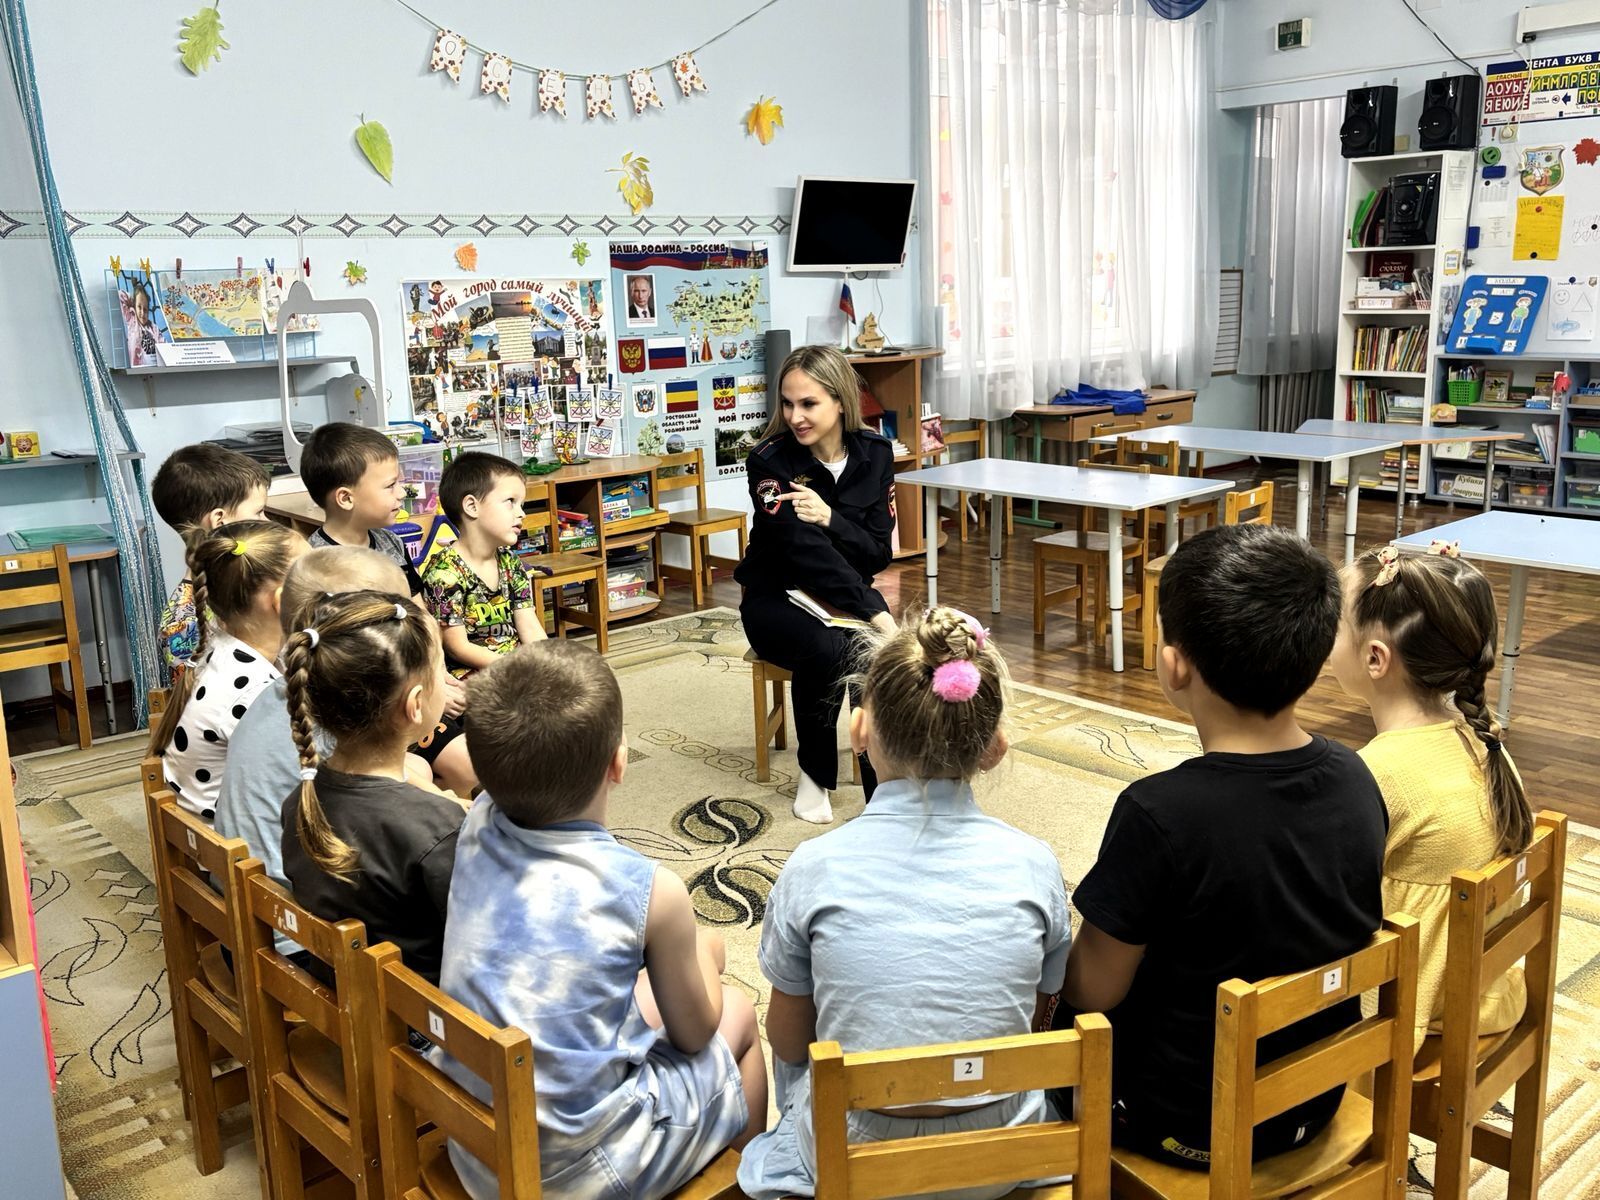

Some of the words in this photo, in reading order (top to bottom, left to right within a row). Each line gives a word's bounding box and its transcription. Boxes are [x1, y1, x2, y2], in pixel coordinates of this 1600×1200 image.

[1565, 54, 1593, 65] БУКВ
[609, 245, 639, 254] НАША
[641, 244, 682, 254] РОДИНА
[691, 243, 725, 253] РОССИЯ
[431, 296, 458, 323] Мой
[463, 279, 497, 298] город
[500, 280, 543, 294] самый
[718, 414, 737, 424] МОЙ
[741, 411, 767, 421] ГОРОД
[718, 468, 748, 476] ВОЛГО
[1330, 973, 1335, 985] 2
[964, 1061, 973, 1075] 2
